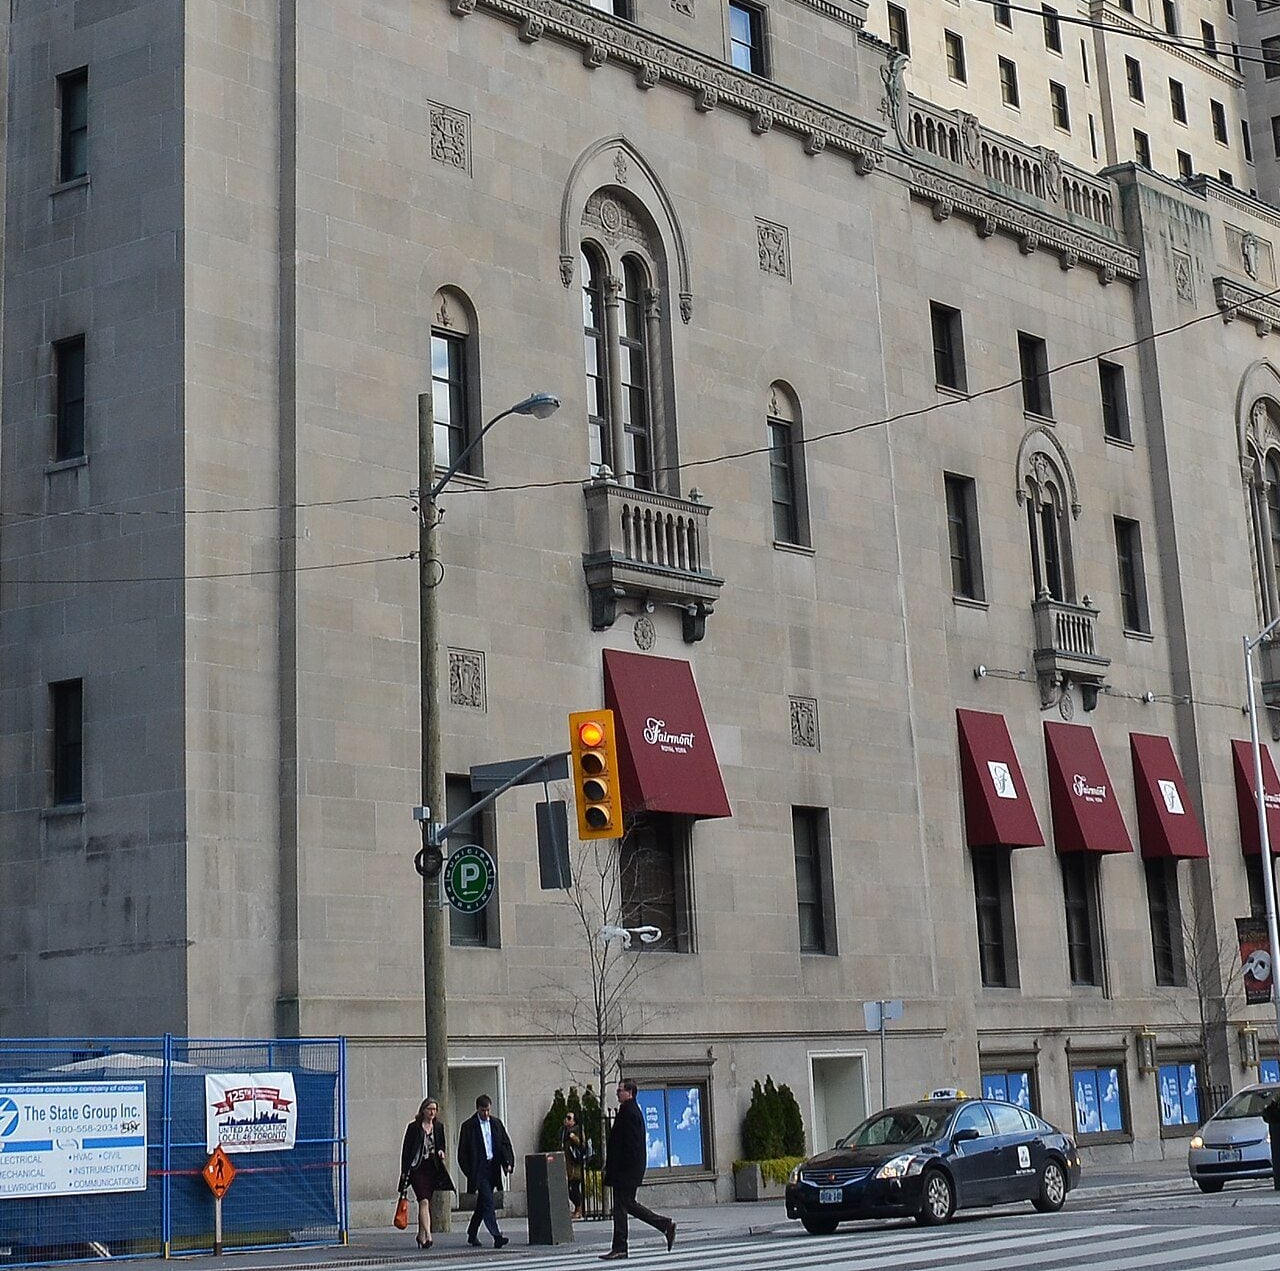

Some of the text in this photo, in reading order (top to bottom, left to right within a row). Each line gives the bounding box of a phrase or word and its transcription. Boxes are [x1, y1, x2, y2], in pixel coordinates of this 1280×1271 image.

[644, 717, 695, 748] Fairmont
[1073, 774, 1106, 798] Fairmont
[447, 849, 492, 877] MUNICIPAL
[461, 863, 480, 889] P
[447, 884, 492, 909] PARKING
[227, 1089, 251, 1101] 125TH
[24, 1103, 140, 1122] The State Group Inc.
[48, 1124, 118, 1134] 1-800-558-2034
[219, 1124, 287, 1134] UNITED ASSOCIATION
[219, 1133, 239, 1142] LOCAL
[254, 1131, 287, 1139] TORONTO
[72, 1152, 94, 1160] HVAC
[103, 1150, 122, 1159] CIVIL
[72, 1164, 140, 1174] INSTRUMENTATION
[74, 1177, 139, 1188] COMMUNICATIONS
